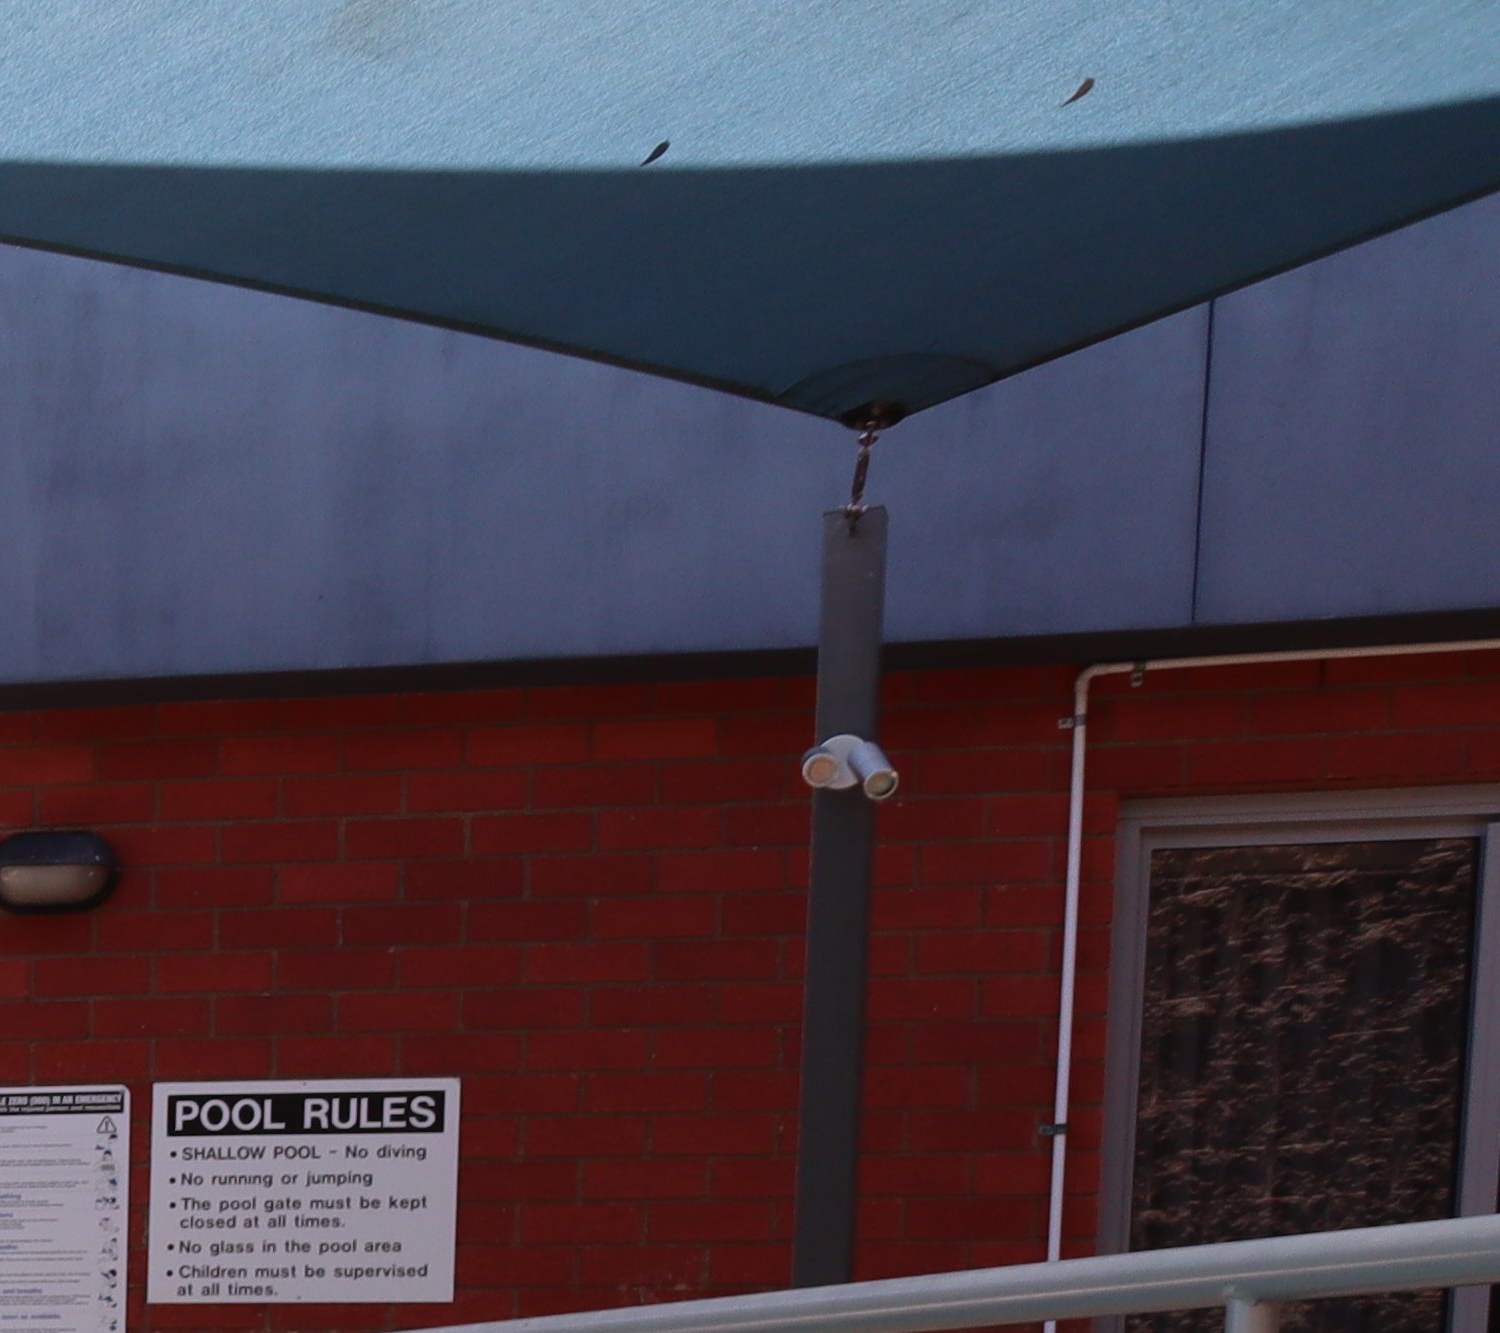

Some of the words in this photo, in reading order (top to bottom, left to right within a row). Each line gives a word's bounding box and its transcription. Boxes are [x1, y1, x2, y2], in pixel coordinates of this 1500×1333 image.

[174, 1098, 286, 1131] POOL
[303, 1095, 436, 1129] RULES
[182, 1146, 266, 1160] SHALLOW
[273, 1145, 321, 1159] POOL
[345, 1144, 369, 1159] No
[376, 1144, 428, 1161] diving
[181, 1172, 204, 1186] No
[211, 1173, 274, 1188] running
[280, 1174, 299, 1185] or
[306, 1171, 374, 1188] jumping
[181, 1197, 211, 1211] The
[219, 1197, 256, 1213] pool
[264, 1197, 301, 1213] gate
[309, 1197, 352, 1210] must
[360, 1196, 381, 1210] be
[389, 1196, 427, 1212] kept
[180, 1215, 236, 1229] closed
[243, 1216, 260, 1229] at
[268, 1215, 286, 1228] all
[294, 1215, 346, 1229] times.
[178, 1241, 202, 1254] No
[210, 1240, 255, 1256] glass
[262, 1240, 277, 1253] in
[285, 1240, 312, 1253] the
[319, 1240, 357, 1256] pool
[364, 1242, 402, 1253] area
[178, 1264, 247, 1279] Children
[255, 1265, 297, 1278] must
[304, 1264, 326, 1278] be
[333, 1264, 428, 1280] supervised
[177, 1284, 193, 1296] at
[201, 1283, 220, 1296] all
[228, 1283, 279, 1296] times.
